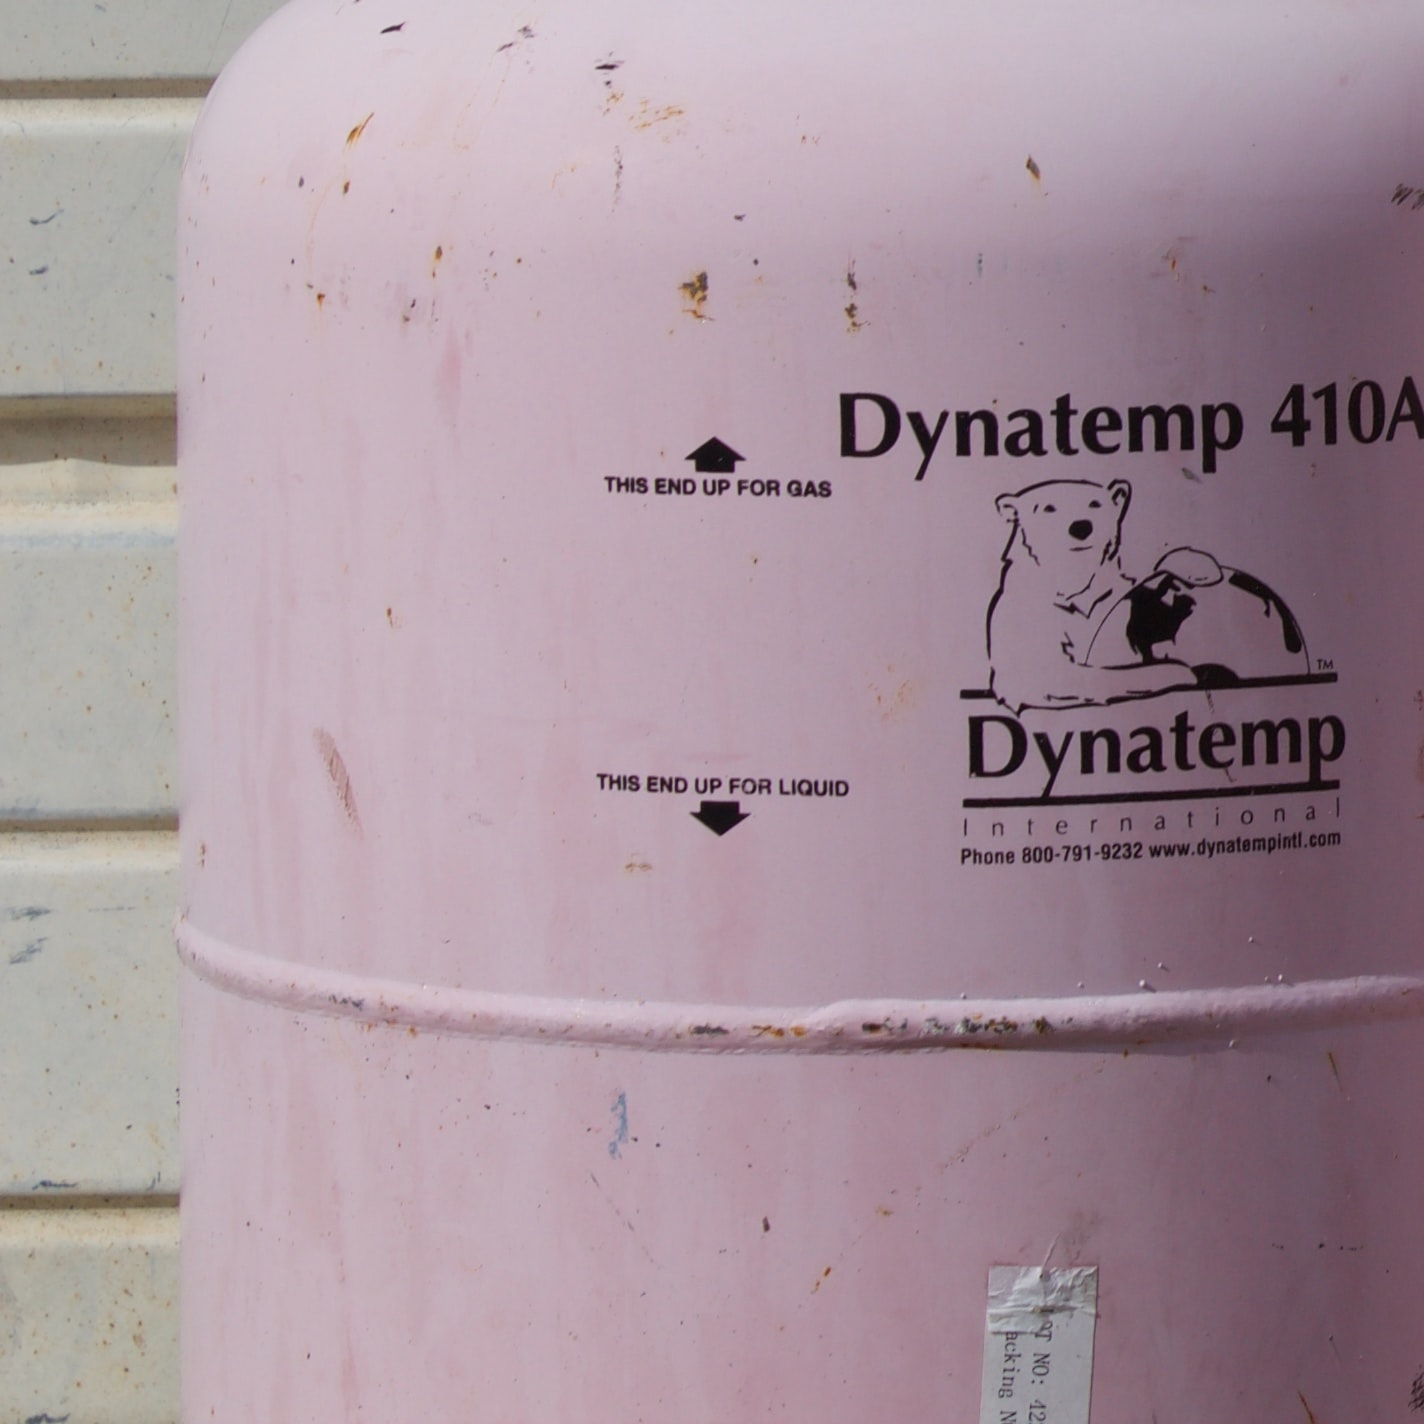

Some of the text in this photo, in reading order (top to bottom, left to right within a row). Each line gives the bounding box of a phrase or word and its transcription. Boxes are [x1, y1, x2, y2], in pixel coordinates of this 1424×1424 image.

[839, 391, 1244, 481] Dynatemp
[604, 476, 832, 497] THIS END UP FOR GAS
[968, 710, 1346, 798] Dynatemp
[596, 773, 850, 797] THIS END UP FOR LIQUID
[963, 797, 1340, 839] International
[960, 831, 1341, 866] Phone 800-791-9232 www.dynatempintl.com
[998, 1331, 1022, 1424] acking N
[1031, 1352, 1051, 1385] NO:
[1029, 1399, 1047, 1424] 42
